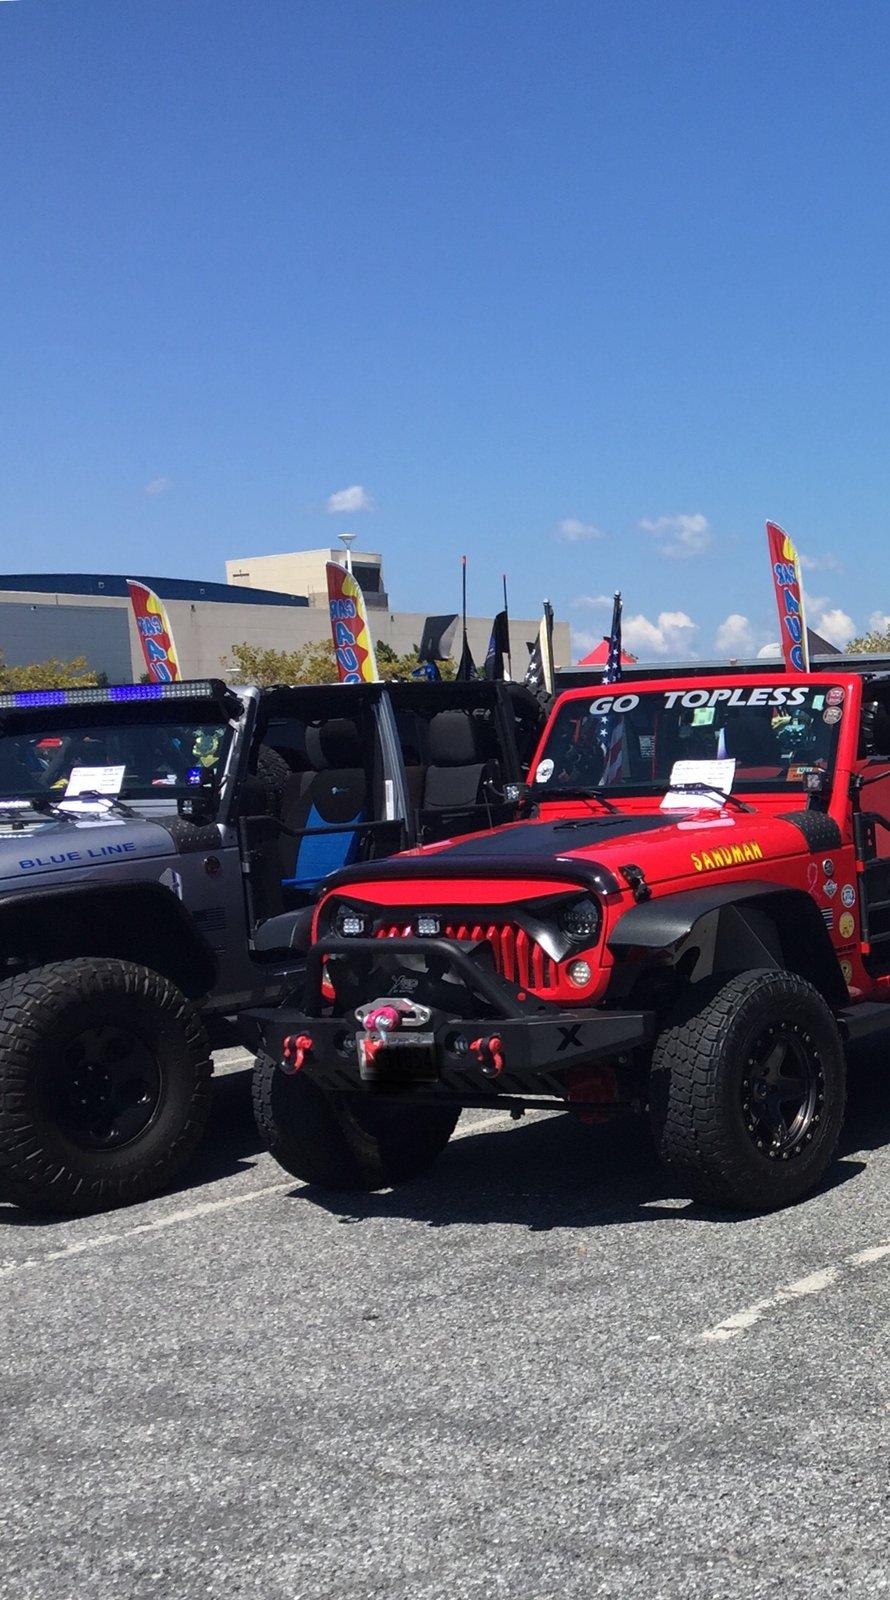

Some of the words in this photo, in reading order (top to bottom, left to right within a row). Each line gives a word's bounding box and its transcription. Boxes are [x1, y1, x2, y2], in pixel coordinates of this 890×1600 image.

[589, 695, 639, 715] GO
[664, 687, 809, 708] TOPLESS
[19, 851, 81, 870] BLUE
[88, 842, 136, 858] LINE
[691, 842, 763, 872] SANDMAN
[557, 1024, 583, 1051] X
